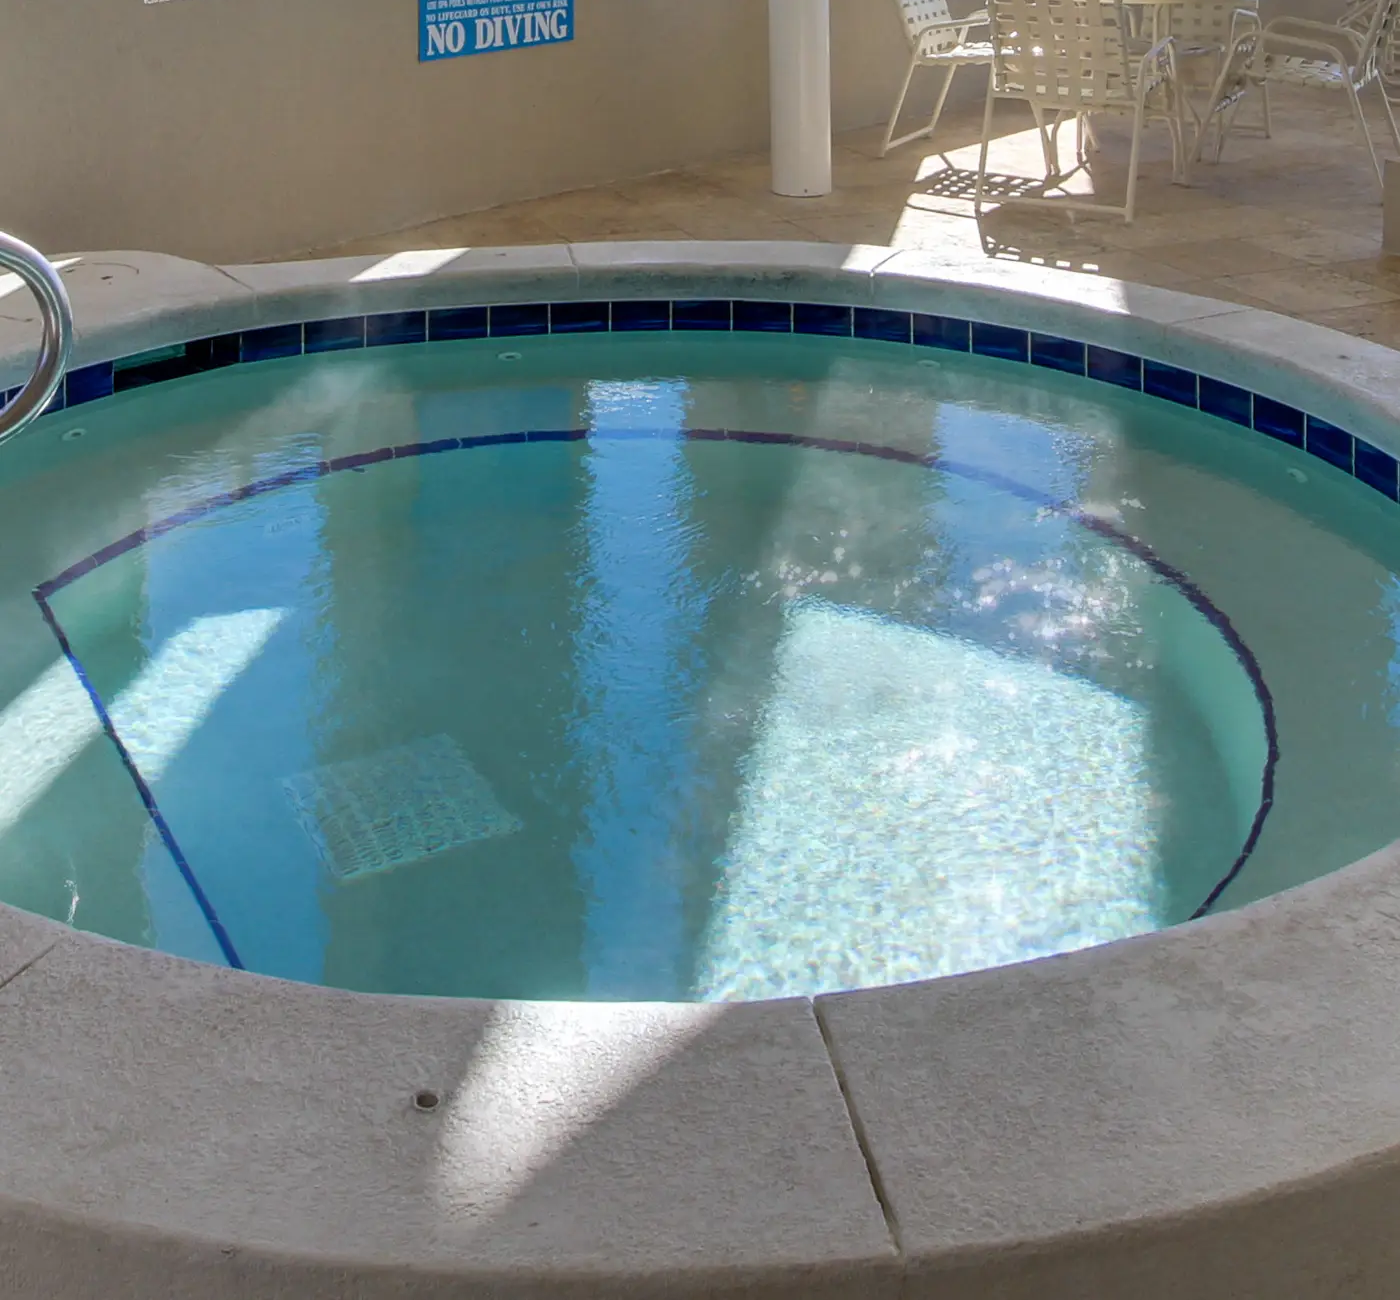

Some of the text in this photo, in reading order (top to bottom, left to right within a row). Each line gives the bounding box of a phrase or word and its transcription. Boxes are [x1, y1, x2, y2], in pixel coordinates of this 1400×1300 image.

[426, 13, 436, 22] NO
[437, 8, 477, 21] LIFEGUARD
[479, 7, 489, 16] ON
[512, 2, 524, 12] USE
[527, 2, 534, 11] AT
[536, 0, 551, 9] OWN
[426, 9, 567, 56] NO DIVING
